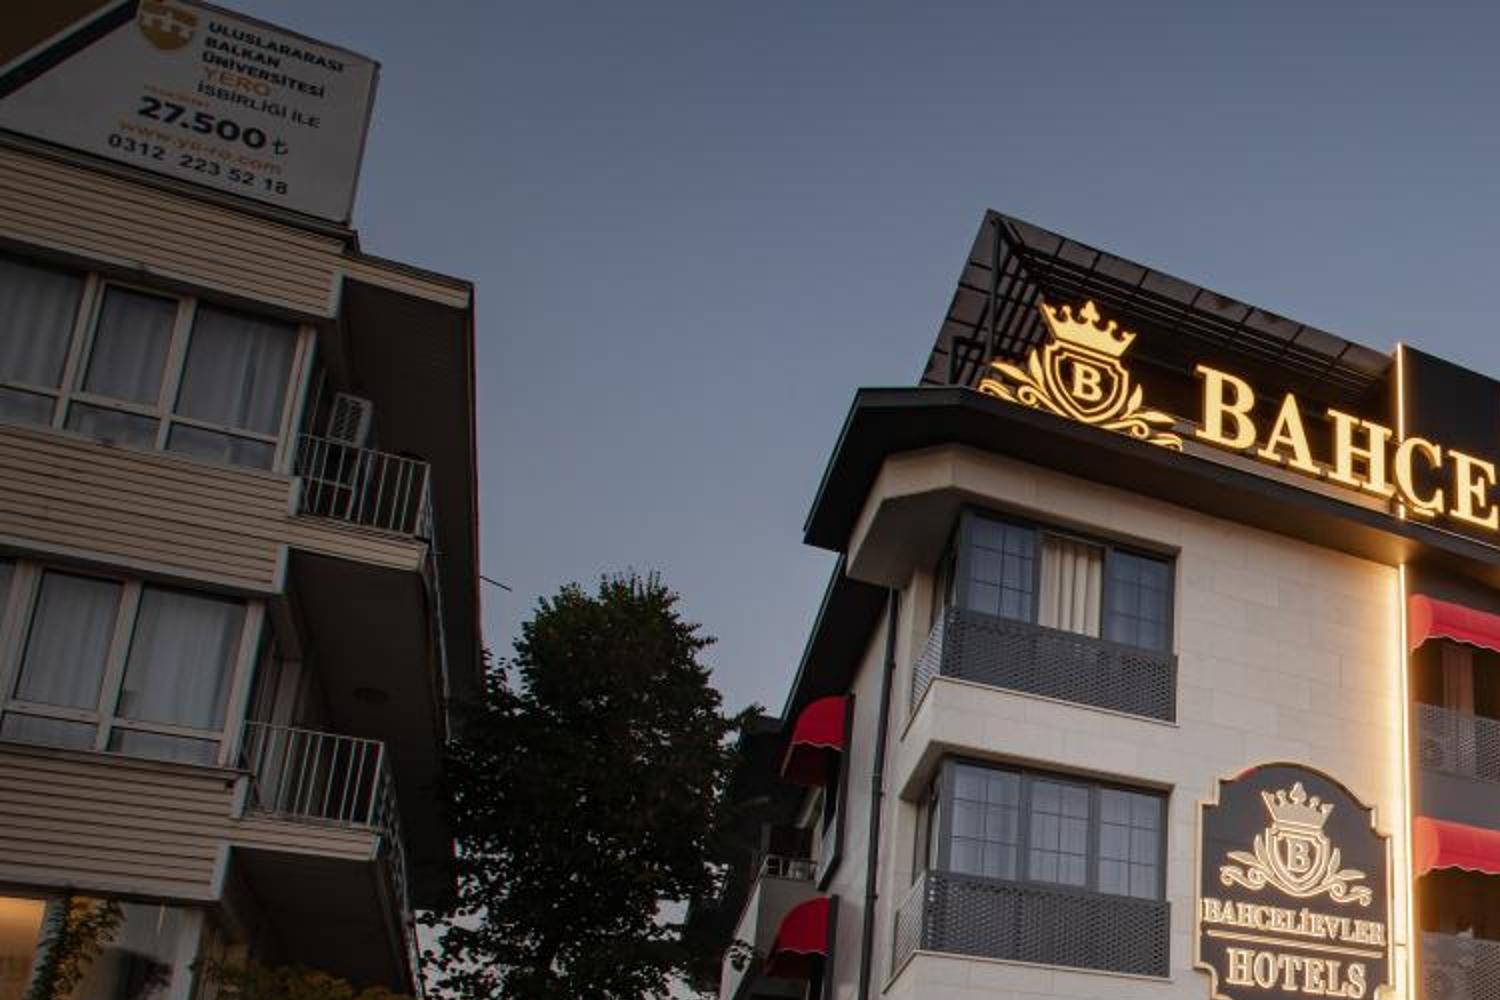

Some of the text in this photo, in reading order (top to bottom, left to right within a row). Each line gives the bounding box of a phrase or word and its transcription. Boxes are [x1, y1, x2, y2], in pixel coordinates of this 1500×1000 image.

[205, 37, 281, 69] BALKAN
[208, 22, 344, 73] ULUSLARARASI
[108, 133, 288, 195] 0312 223 52 18
[1072, 362, 1103, 401] B
[1225, 947, 1367, 999] HOTELS
